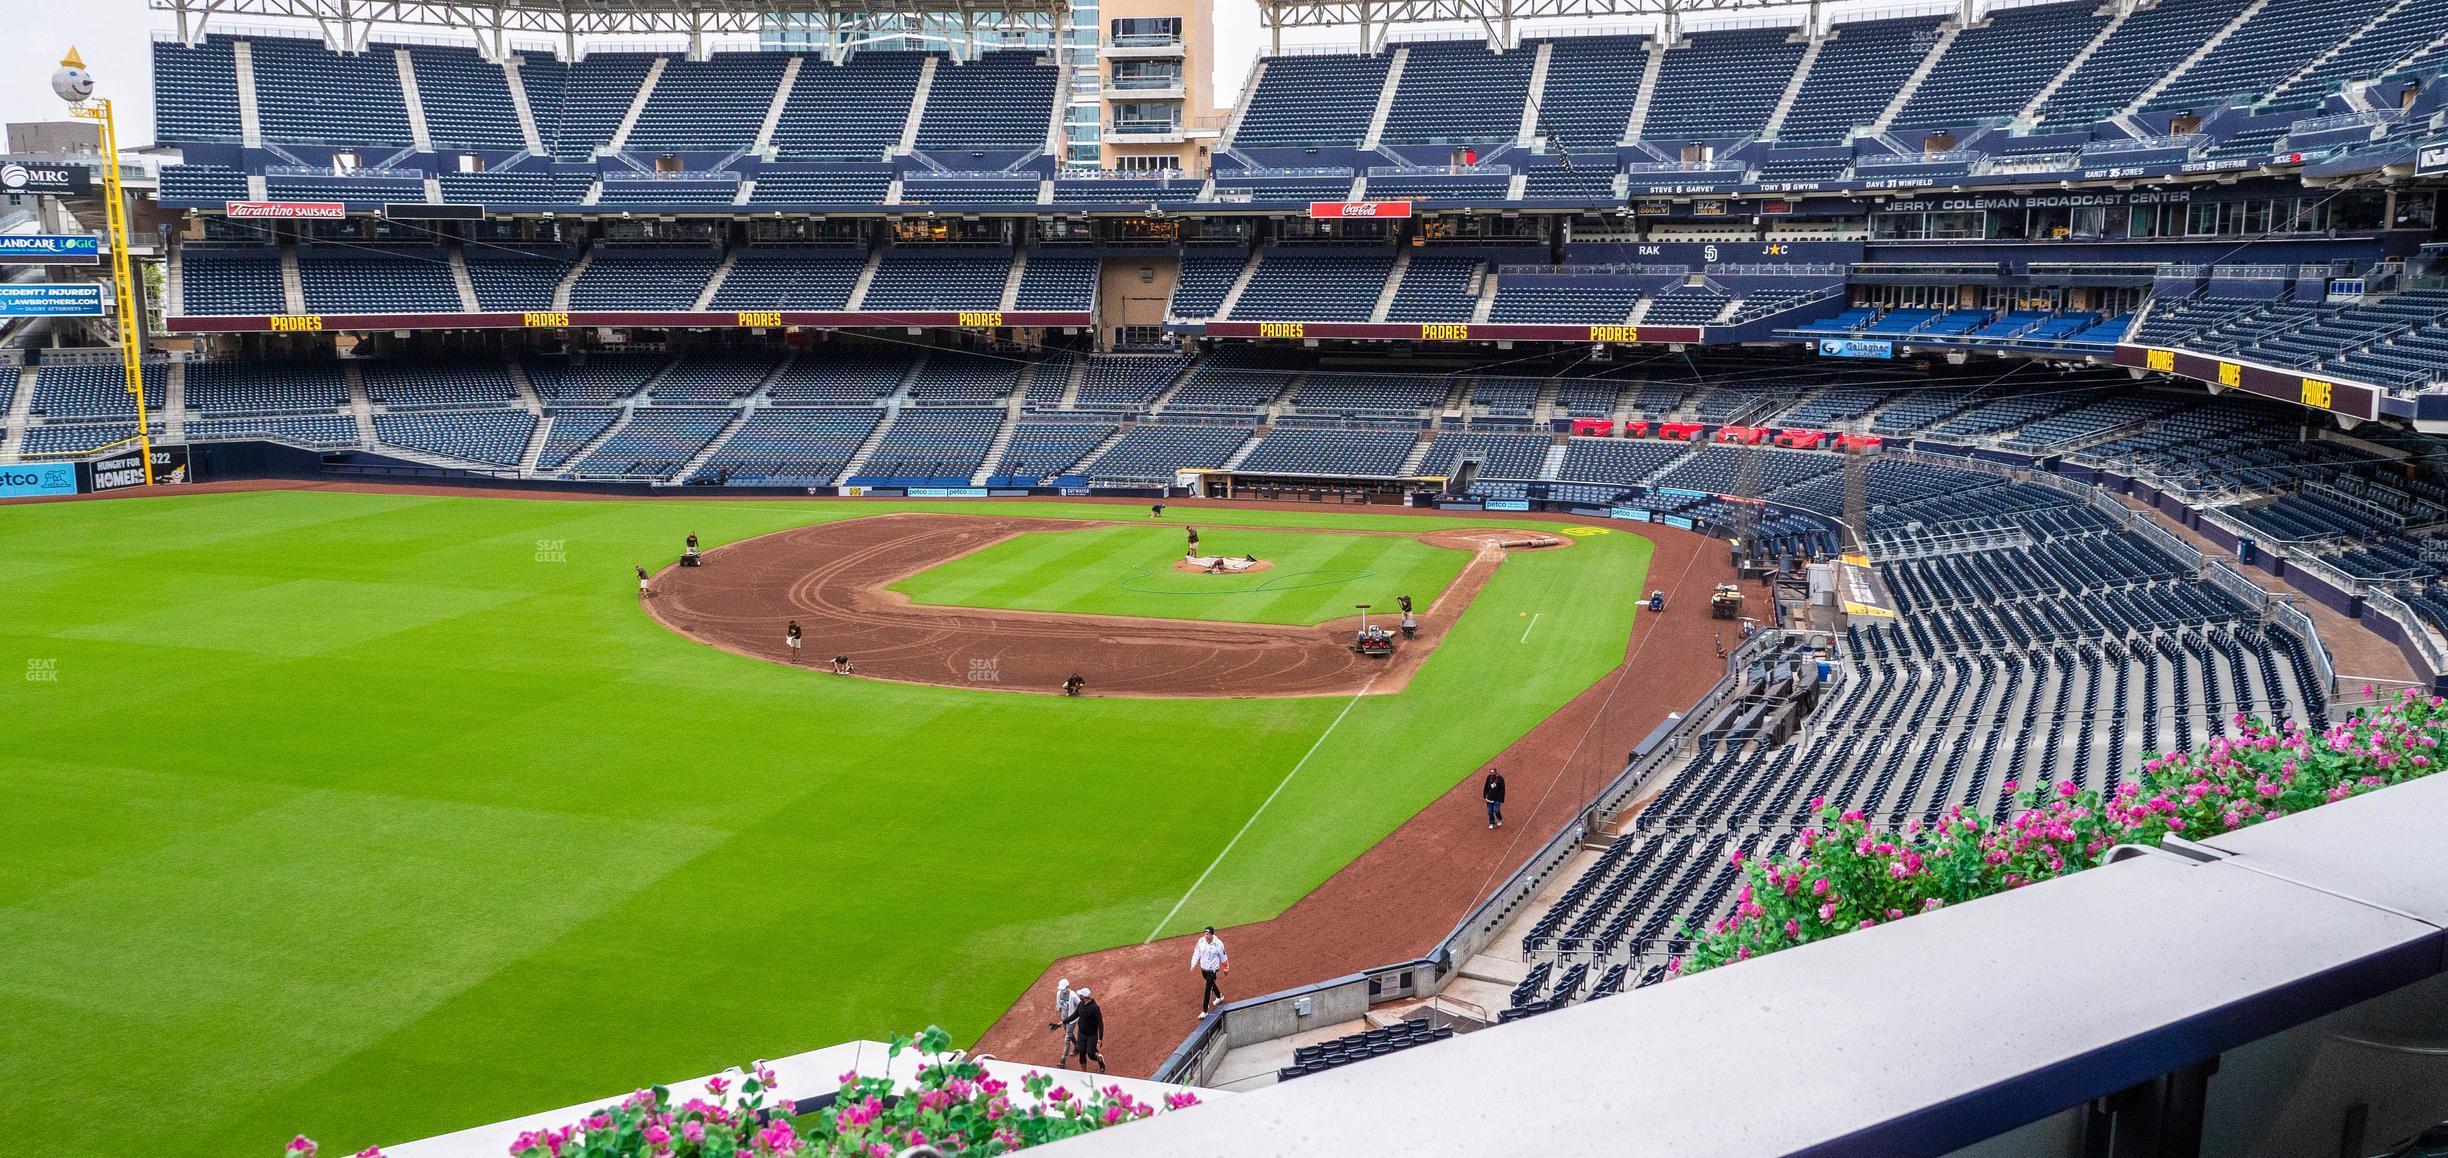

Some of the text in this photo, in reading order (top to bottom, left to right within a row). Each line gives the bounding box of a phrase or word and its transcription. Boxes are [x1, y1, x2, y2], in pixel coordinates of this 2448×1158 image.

[2084, 168, 2144, 178] RANDY 35 JONES
[2206, 161, 2216, 171] 51
[29, 170, 69, 182] MRC
[1676, 185, 1683, 194] 6
[1686, 185, 1715, 193] GARVEY
[1781, 183, 1791, 191] 19
[1886, 180, 1897, 188] 31
[1898, 179, 1933, 187] WINFIELD
[1885, 191, 2191, 211] JERRY COLEMAN BROADCAST CENTER
[230, 203, 343, 217] Tarantino SAUSAGES
[60, 238, 96, 249] LOGIC
[1639, 246, 1660, 255] RAK
[270, 316, 322, 331] PADRES
[524, 313, 569, 327] PADRES
[738, 312, 781, 327] PADRES
[959, 312, 1002, 327] PADRES
[1260, 323, 1303, 338] PADRES
[1421, 325, 1467, 340] PADRES
[1590, 326, 1637, 342] PADRES
[1846, 342, 1889, 352] Gallagher
[2147, 349, 2175, 371] PADRES
[2218, 361, 2241, 387] PADRES
[2301, 378, 2332, 409] PADRES
[97, 457, 141, 471] HUNGRY FOR
[150, 453, 171, 465] 322
[95, 468, 145, 489] HOMERS
[1612, 509, 1630, 517] petco
